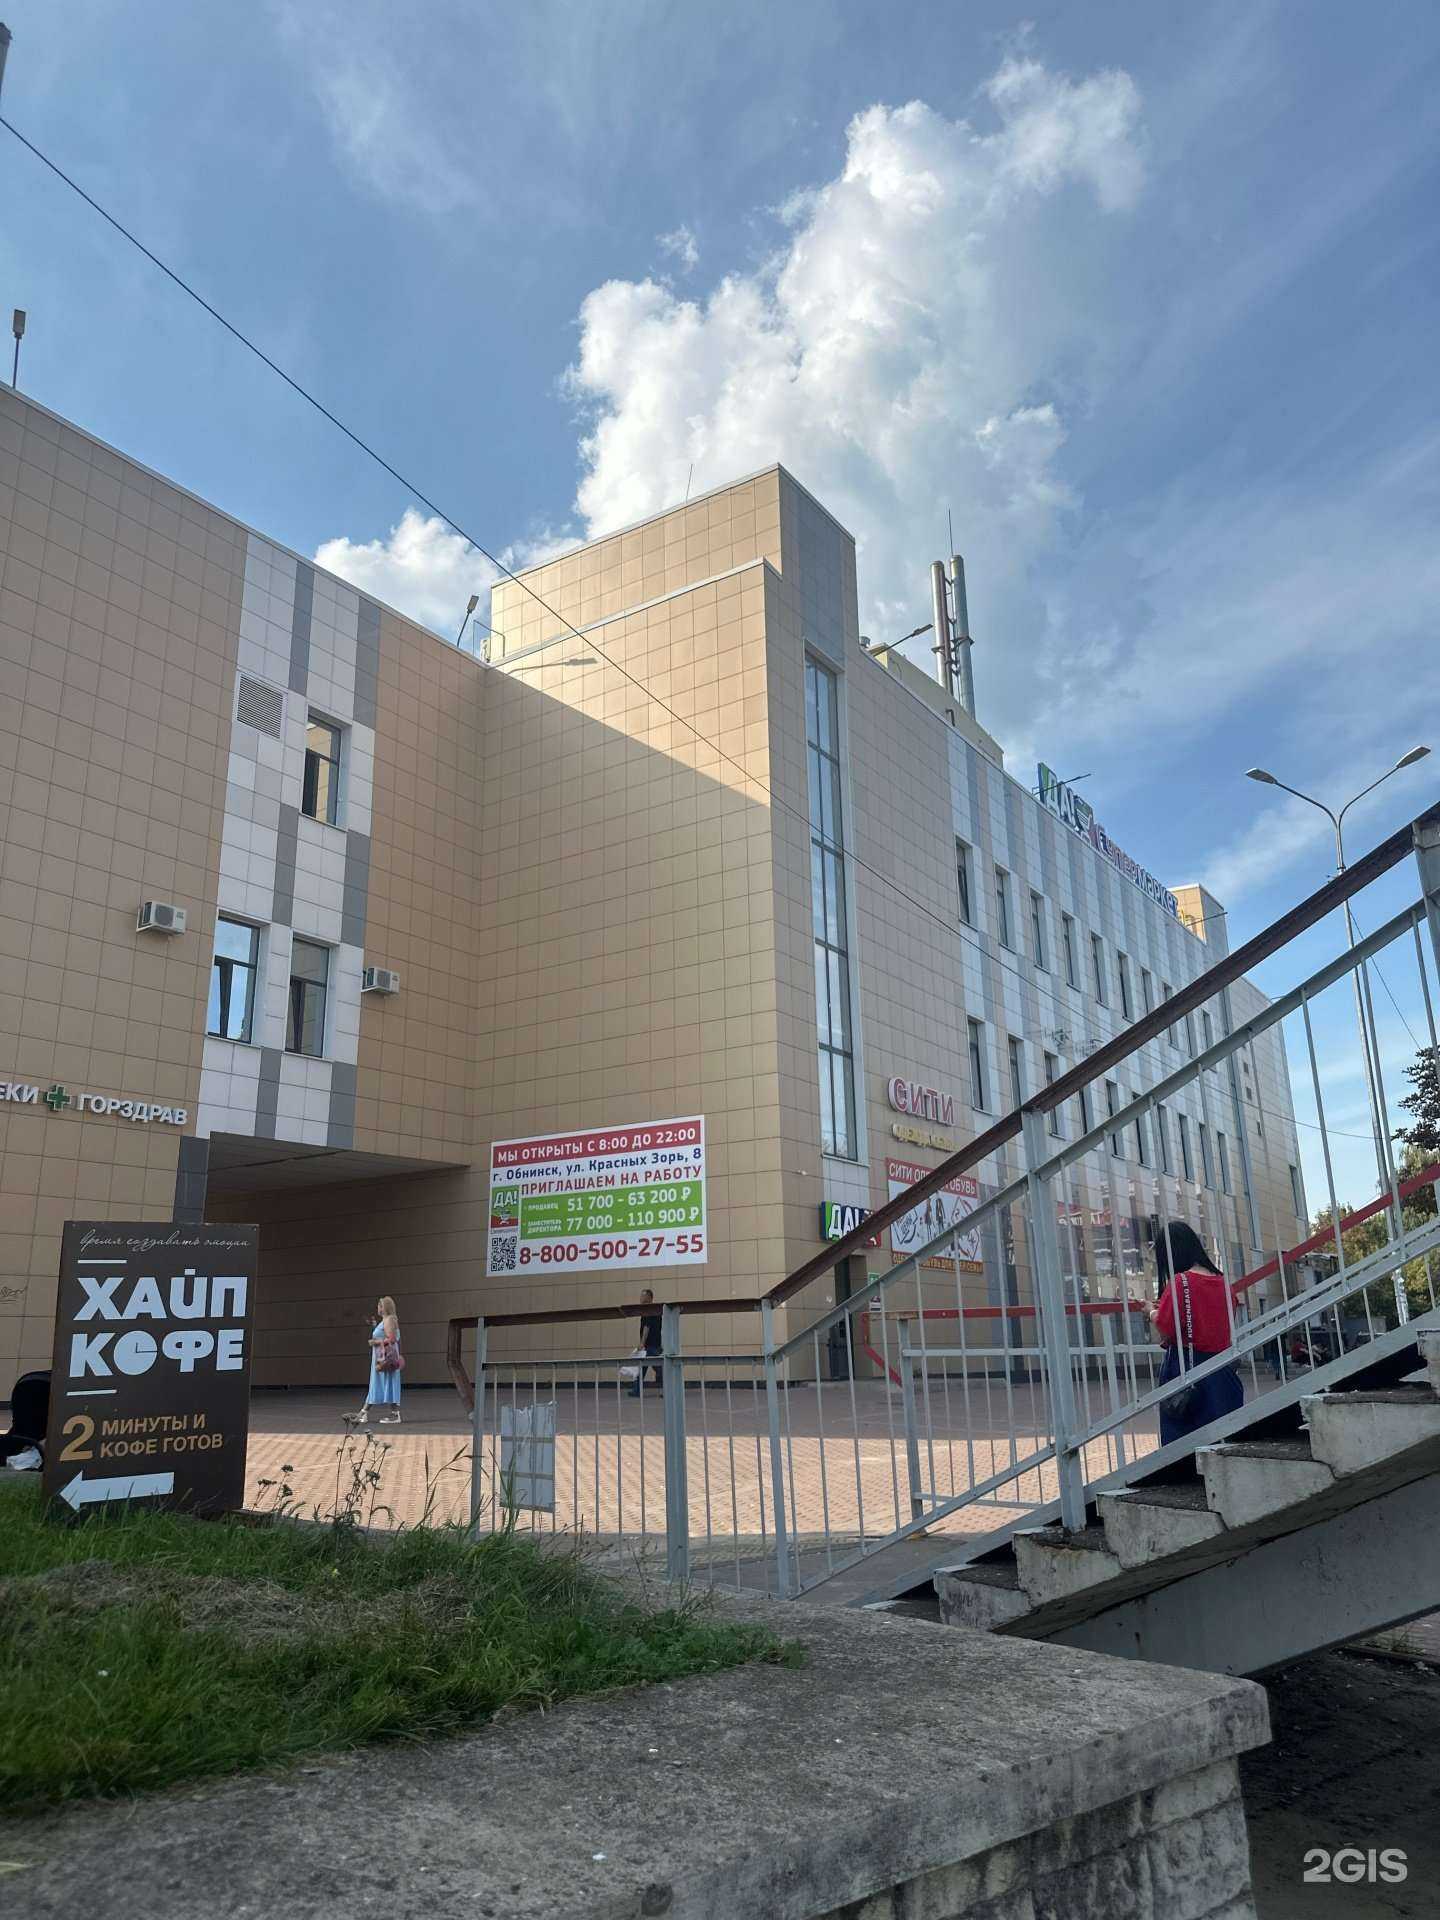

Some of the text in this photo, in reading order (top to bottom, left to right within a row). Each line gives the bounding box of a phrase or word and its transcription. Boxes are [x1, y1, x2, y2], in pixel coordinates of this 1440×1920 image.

[77, 1093, 188, 1125] ГОРЗДРАВ
[889, 1077, 955, 1126] СИТИ
[498, 1128, 696, 1162] МЫ ОТКРЫТЫ С 8:00 ДО 22:00
[493, 1148, 701, 1181] г. Обнинск, ул. Красных Зорь, 8
[522, 1165, 701, 1195] ПРИГЛАШАЕМ НА РАБОТУ
[889, 1162, 912, 1181] СИТИ
[949, 1178, 976, 1194] ОБУВЬ
[493, 1190, 517, 1208] ДА!
[567, 1198, 583, 1212] 51
[588, 1195, 614, 1210] 700
[628, 1192, 646, 1206] 63
[650, 1188, 677, 1204] 200
[567, 1218, 582, 1232] 77
[587, 1214, 613, 1230] 000
[628, 1211, 654, 1227] 110
[658, 1208, 686, 1224] 900
[520, 1234, 704, 1265] 8-800-500-27-55
[73, 1269, 248, 1320] ХАЙП
[68, 1329, 244, 1377] КОФЕ
[60, 1414, 206, 1462] 2 МИНУТЫ И
[100, 1432, 223, 1459] КОФЕ ГОТОВ
